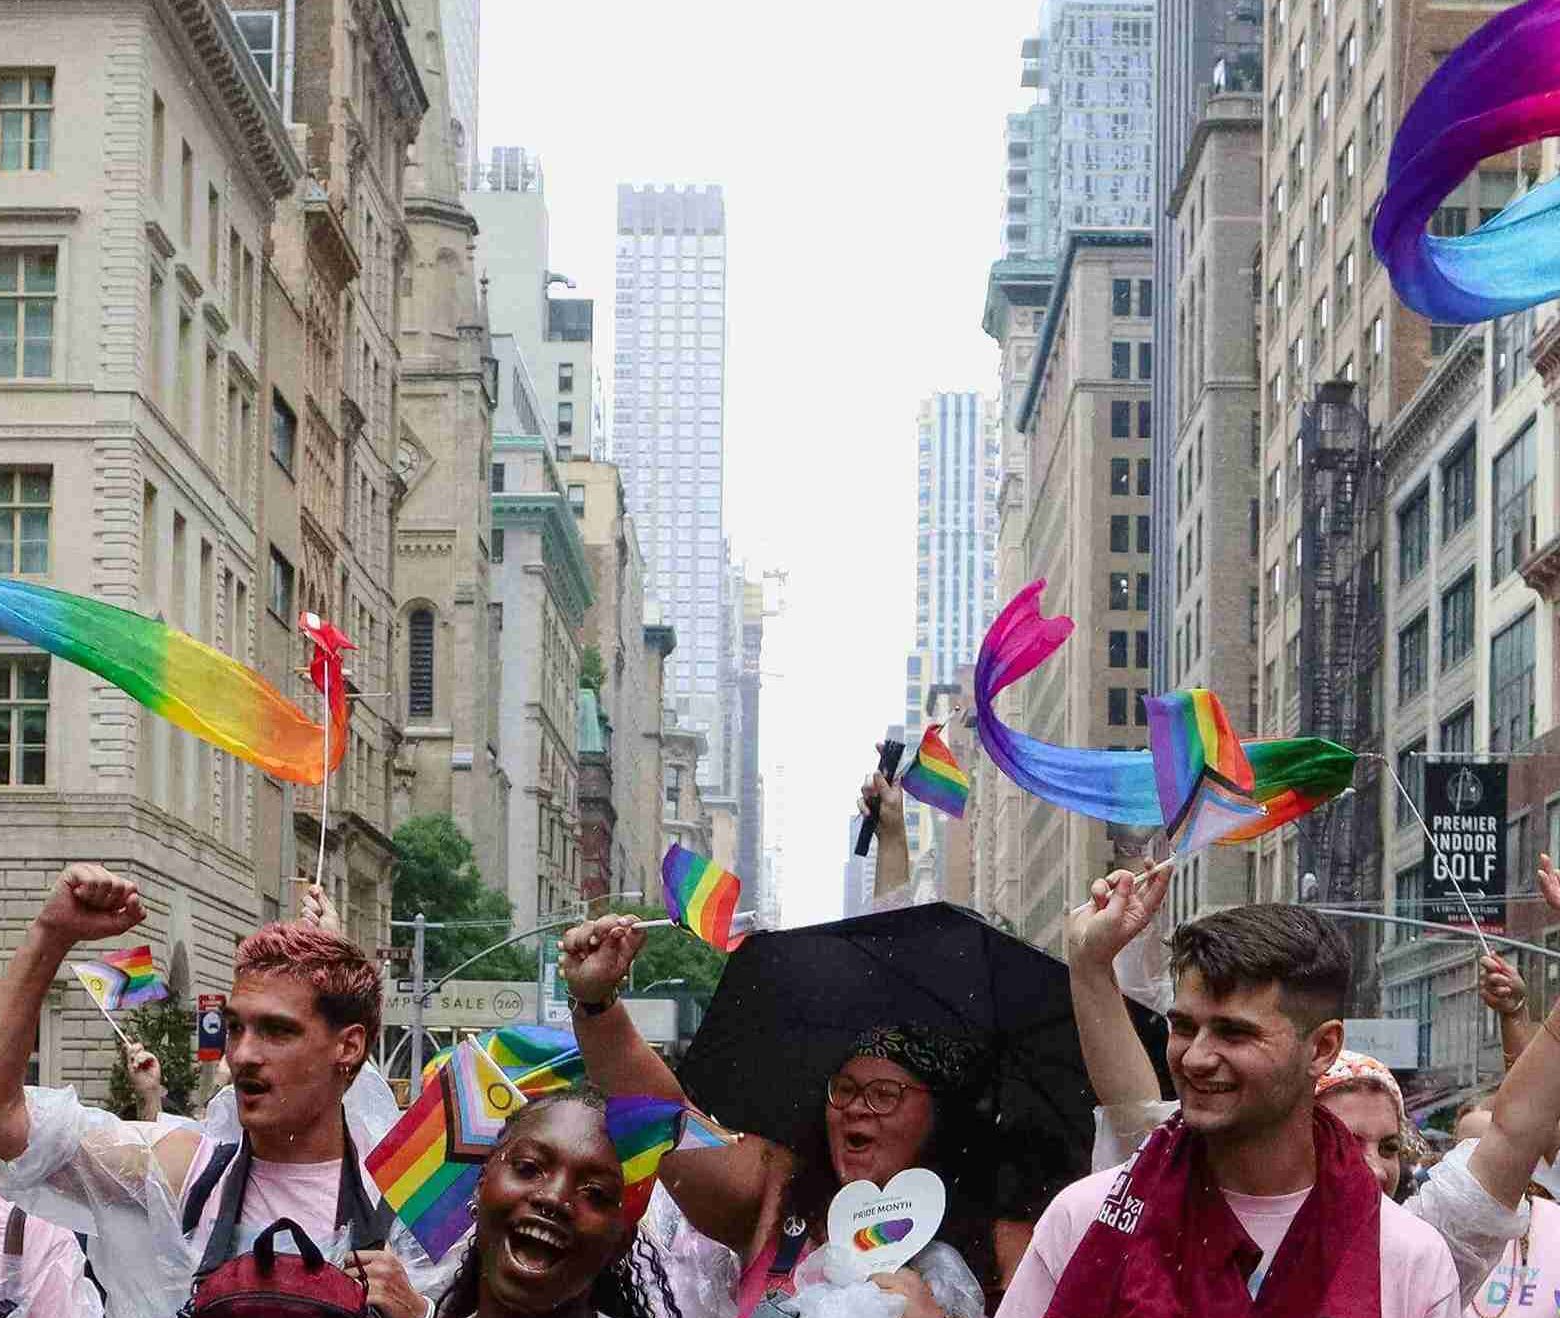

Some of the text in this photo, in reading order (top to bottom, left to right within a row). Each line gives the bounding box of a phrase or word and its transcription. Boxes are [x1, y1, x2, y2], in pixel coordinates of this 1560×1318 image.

[1433, 815, 1497, 831] PREMIER
[1433, 833, 1497, 852] INDOOR
[1433, 853, 1497, 882] GOLF
[441, 997, 486, 1009] SALE
[853, 1201, 912, 1219] PRIDE MONTH
